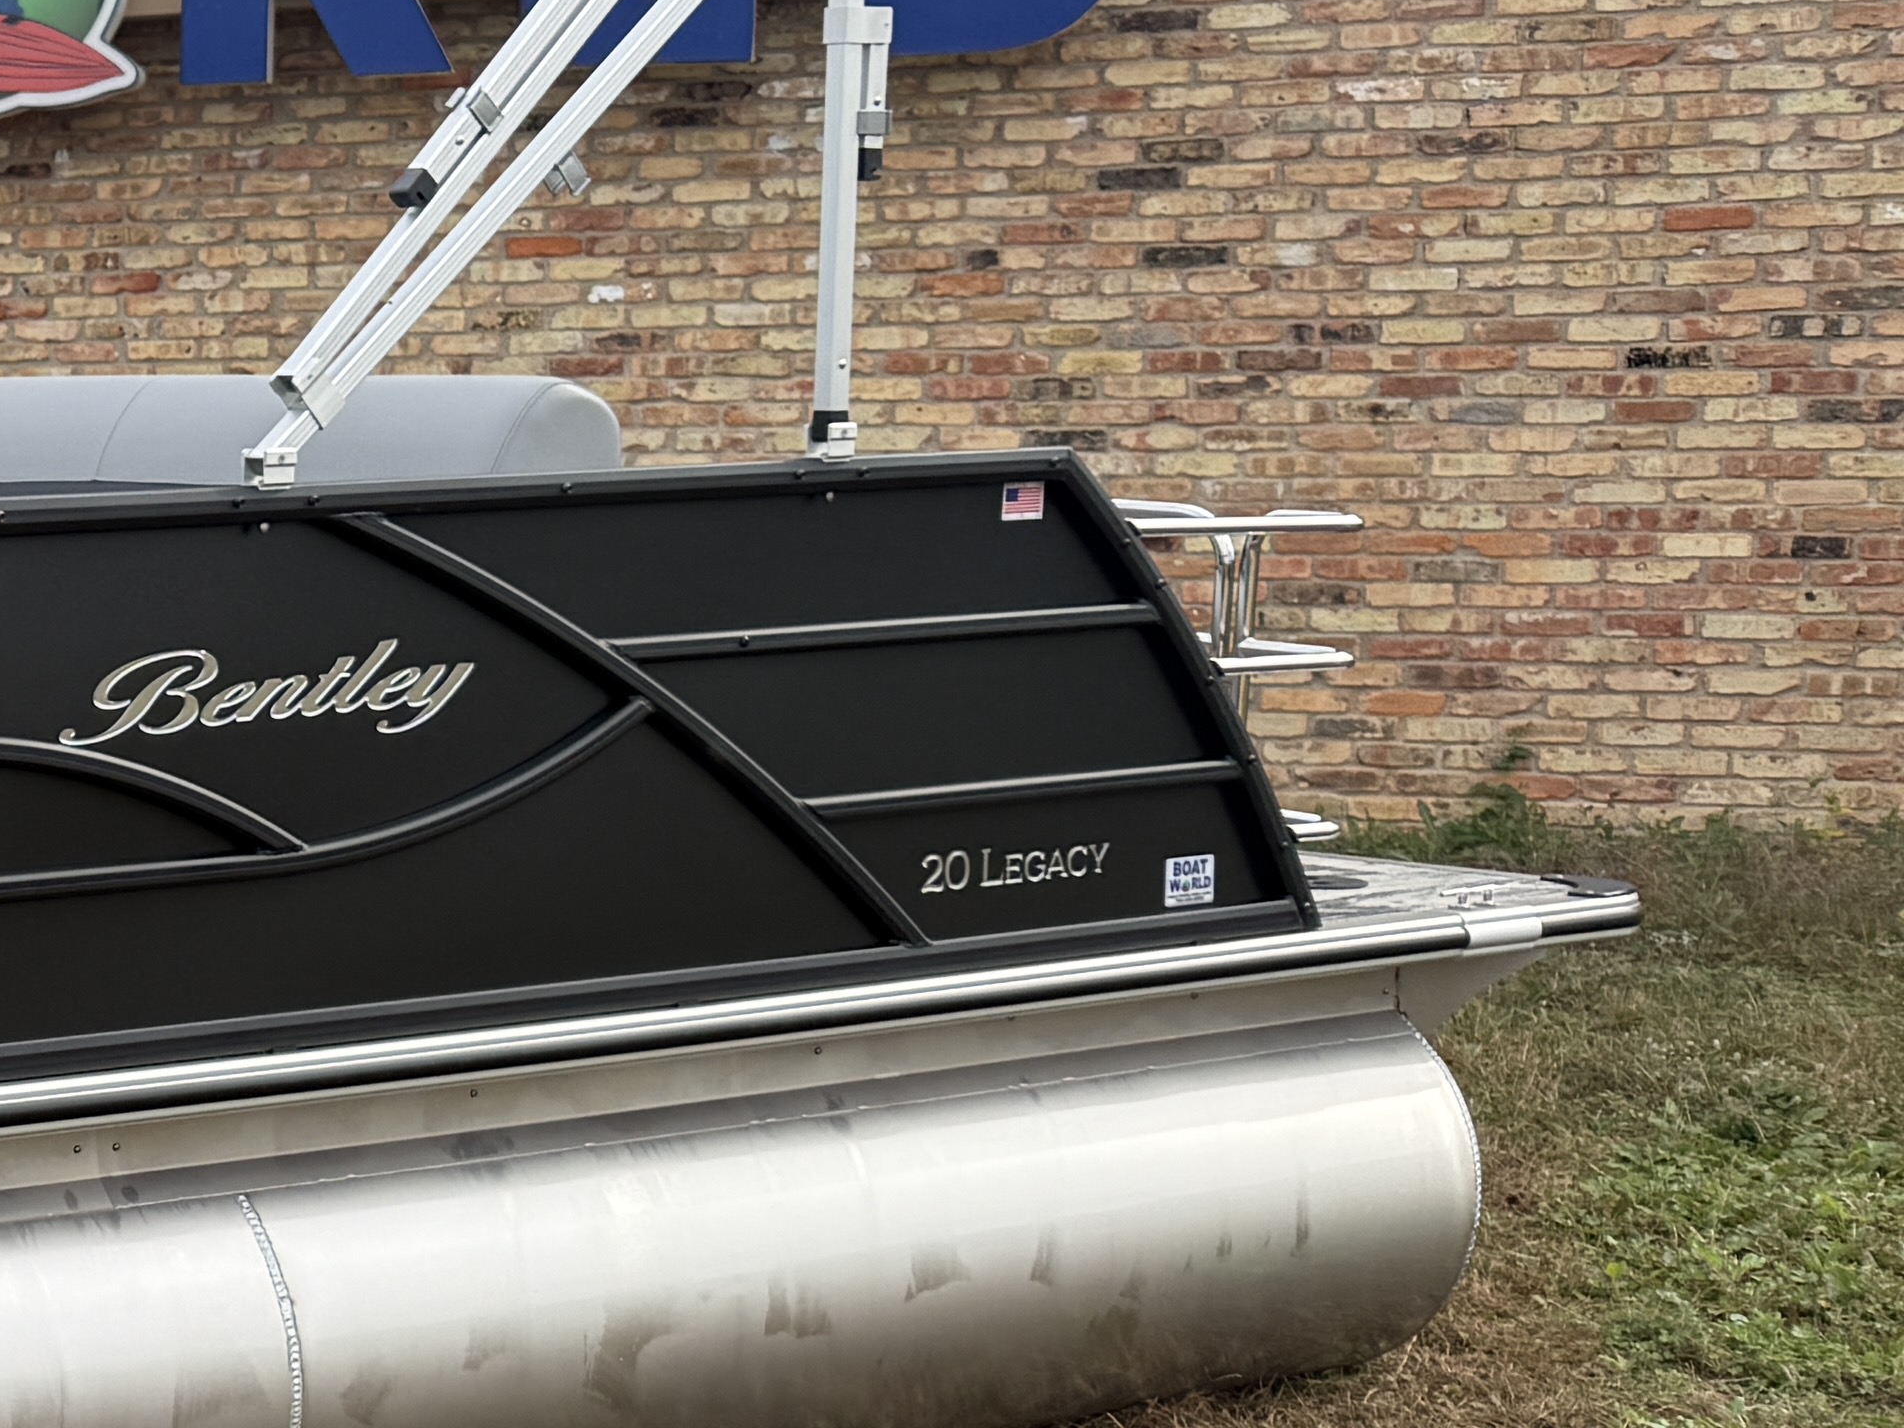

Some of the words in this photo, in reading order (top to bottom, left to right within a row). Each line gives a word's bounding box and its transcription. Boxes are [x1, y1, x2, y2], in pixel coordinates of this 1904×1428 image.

[58, 638, 476, 746] Bentley
[920, 850, 971, 894] 20
[979, 842, 1110, 888] LEGACY
[1172, 858, 1209, 877] BOAT
